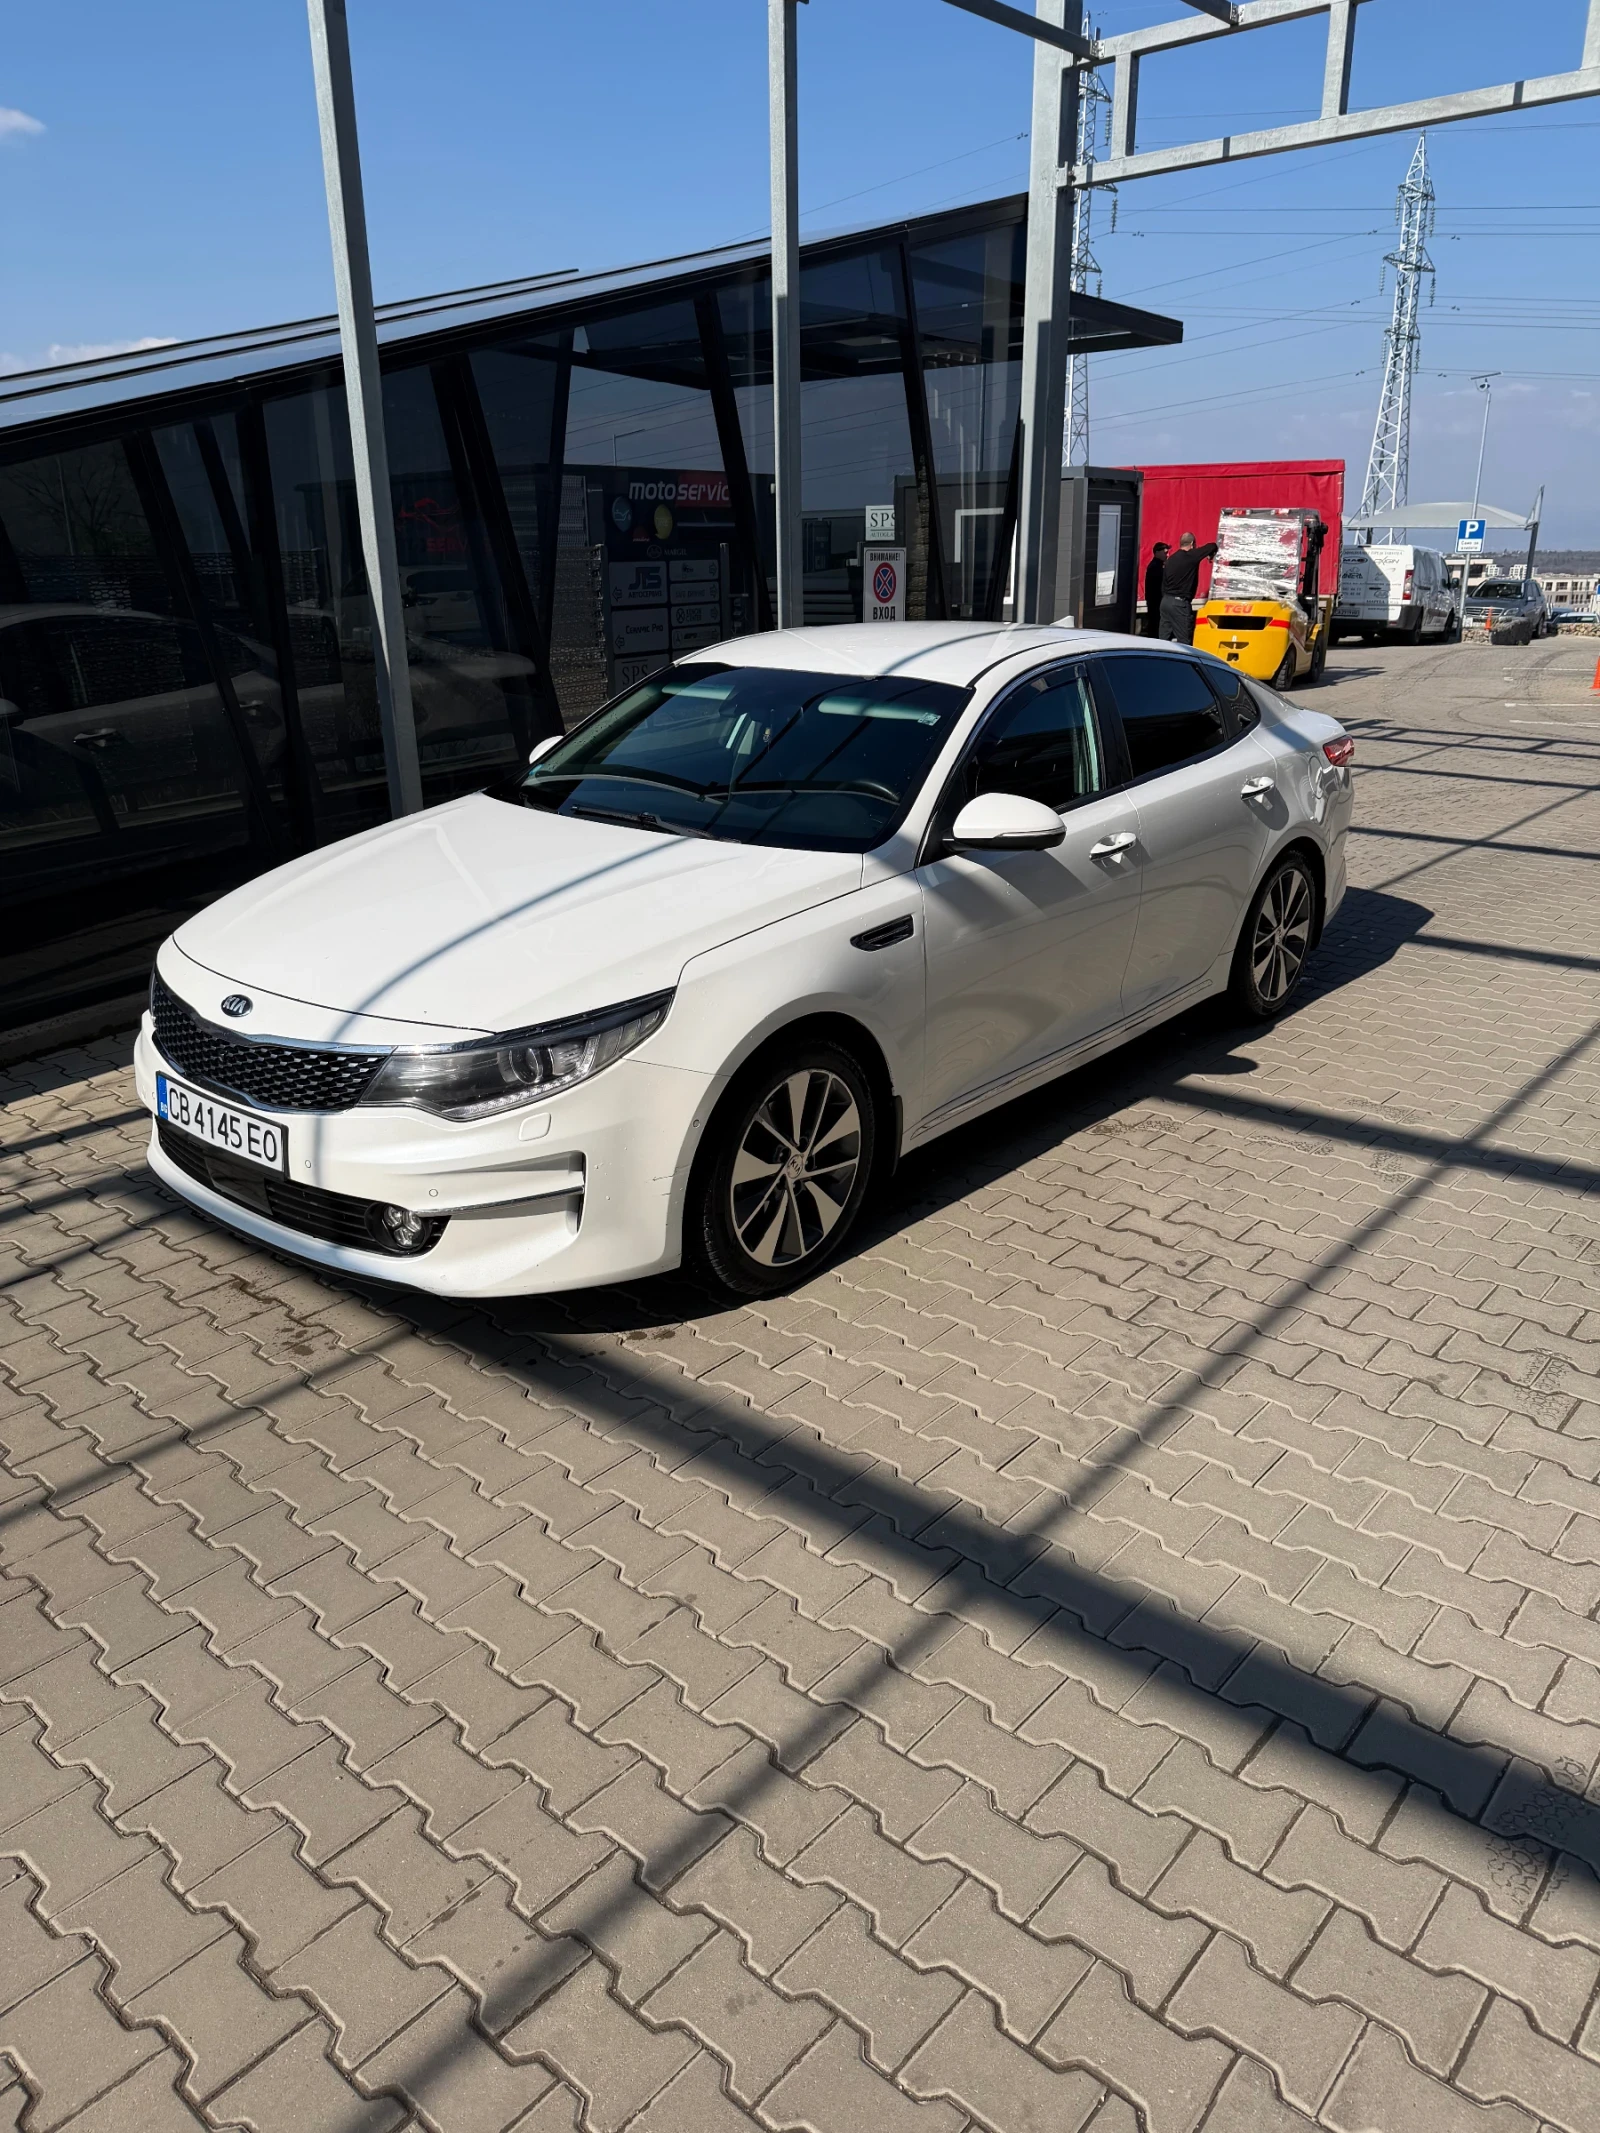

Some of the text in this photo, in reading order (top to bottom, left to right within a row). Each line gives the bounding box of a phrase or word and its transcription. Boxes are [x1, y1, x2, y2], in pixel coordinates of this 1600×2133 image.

[1465, 521, 1479, 538] P
[869, 552, 901, 562] ВНИМАНИЕ!
[873, 607, 896, 621] ВХОД
[222, 996, 247, 1014] KIA
[169, 1087, 278, 1162] CB 4145 EO
[790, 1159, 802, 1175] KIA
